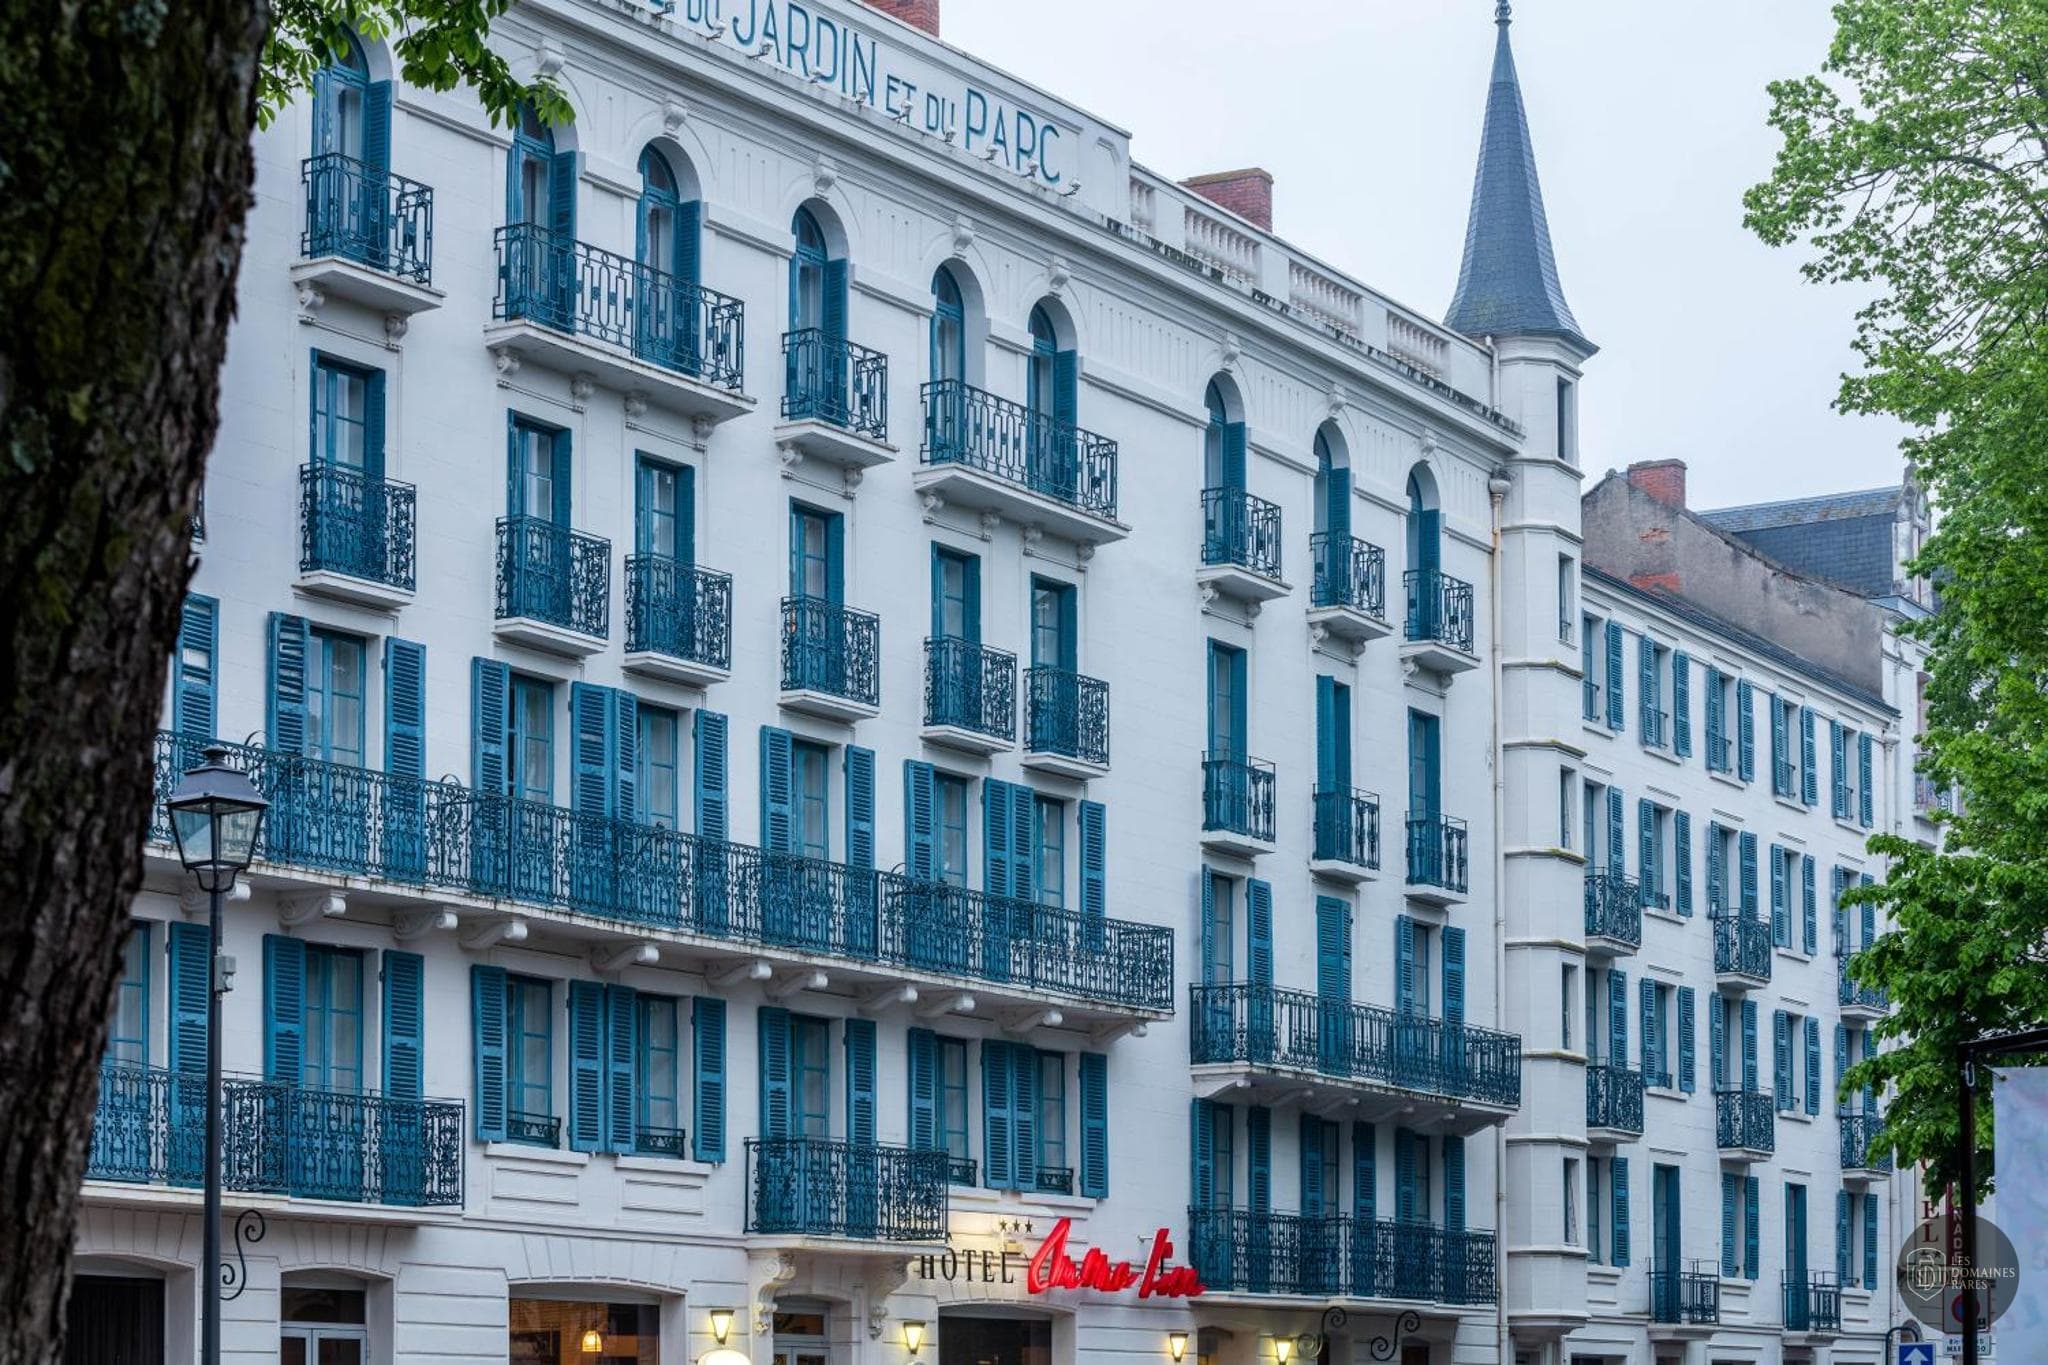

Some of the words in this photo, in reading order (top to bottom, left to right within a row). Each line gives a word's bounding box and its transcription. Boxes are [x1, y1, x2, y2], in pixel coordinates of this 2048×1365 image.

[732, 0, 877, 108] JARDIN
[885, 75, 918, 125] ET
[965, 87, 1061, 184] PARC
